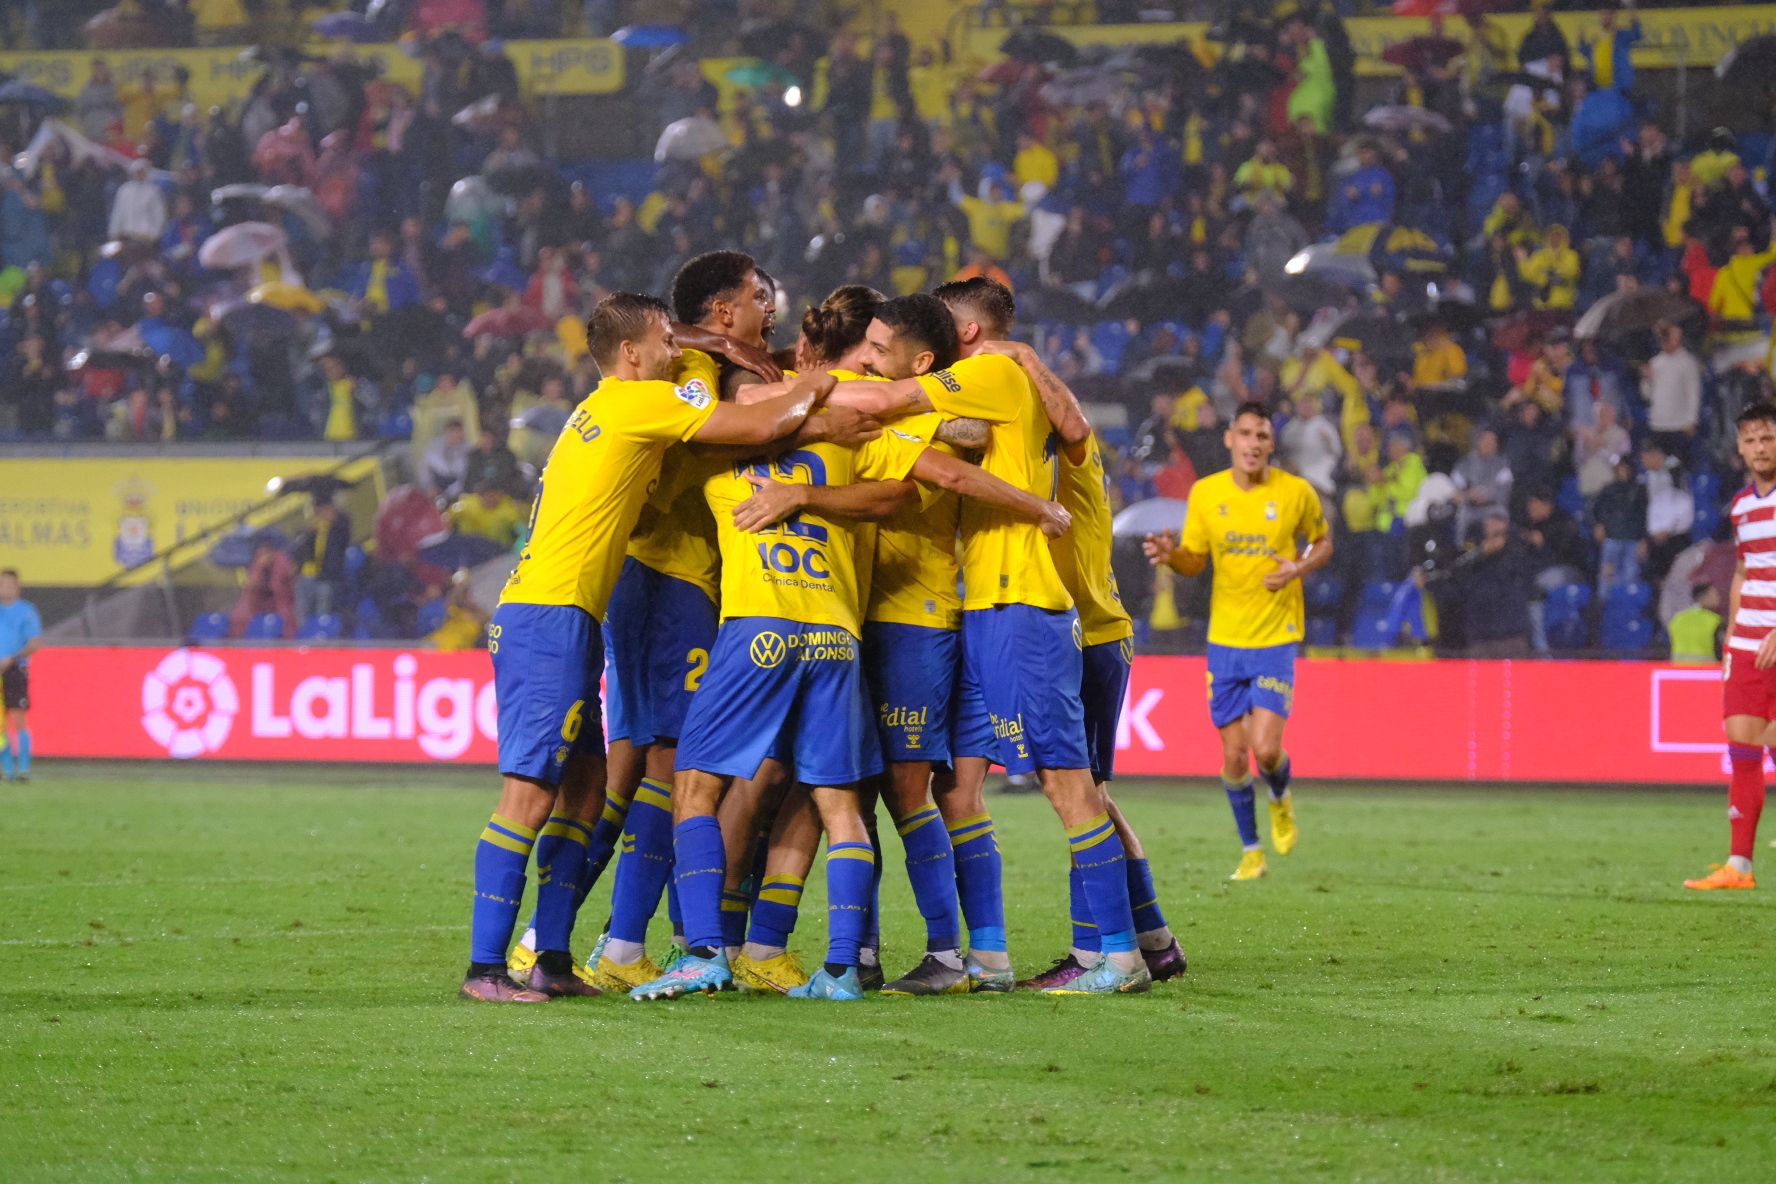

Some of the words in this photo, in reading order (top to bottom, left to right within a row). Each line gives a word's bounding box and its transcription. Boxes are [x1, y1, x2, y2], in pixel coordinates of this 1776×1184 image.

[758, 542, 830, 579] IOC
[800, 580, 836, 593] Dental
[787, 631, 853, 648] DOMINGO
[797, 646, 855, 661] ALONSO
[684, 647, 709, 692] 2
[561, 699, 585, 743] 6
